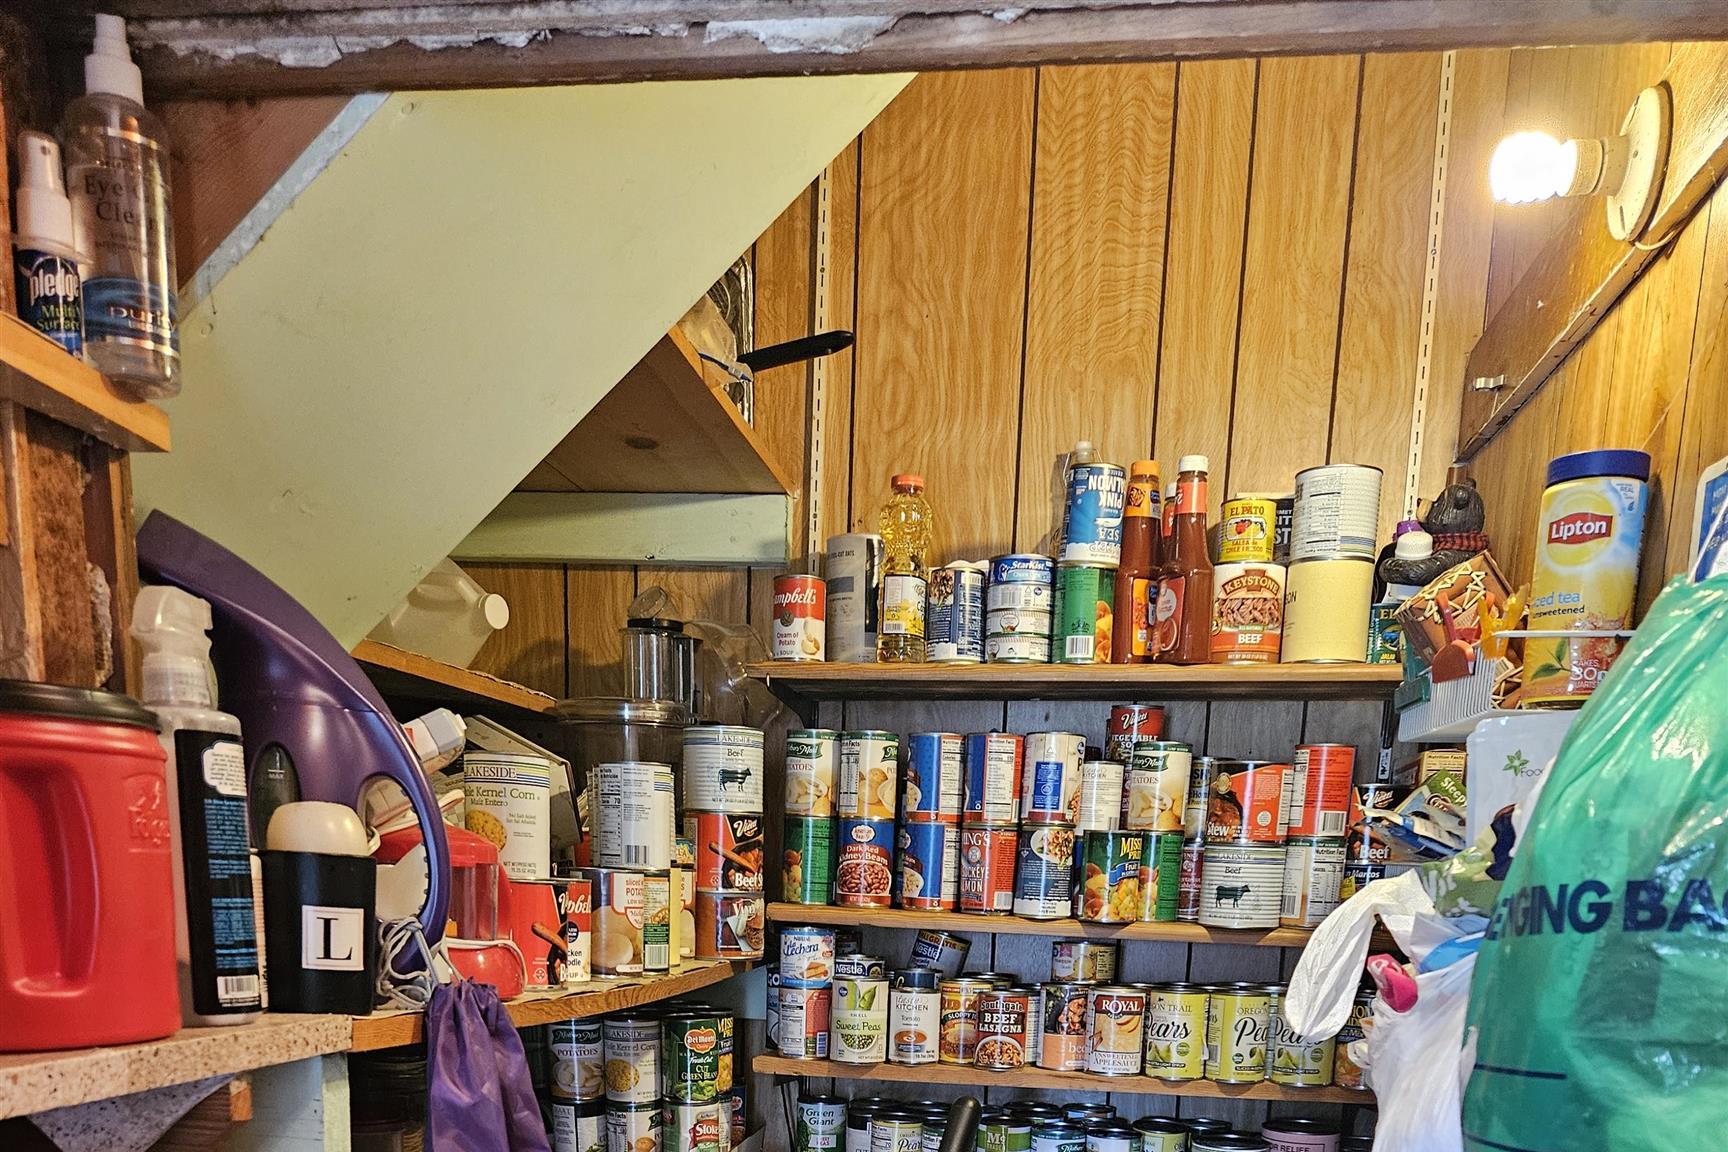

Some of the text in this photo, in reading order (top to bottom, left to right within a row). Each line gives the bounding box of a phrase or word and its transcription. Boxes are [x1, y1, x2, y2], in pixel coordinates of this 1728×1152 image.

[30, 267, 80, 306] pledge
[1099, 491, 1123, 509] PINK
[1230, 506, 1265, 516] EL PATO
[1099, 527, 1120, 541] SEA
[1551, 519, 1607, 540] Lipton
[1012, 560, 1045, 570] StarKist
[1224, 575, 1280, 595] KEYSTONE
[1558, 592, 1581, 604] tea
[778, 639, 796, 647] Potato
[1238, 633, 1263, 644] BEEF
[727, 749, 744, 757] Beef
[465, 767, 516, 778] LAKESIDE
[476, 787, 536, 800] Kernel Corn
[1207, 822, 1229, 837] Stew
[847, 845, 879, 854] Dark Red
[1360, 845, 1390, 860] Beef
[1224, 866, 1242, 875] Beef
[1352, 869, 1381, 879] Marcos
[735, 872, 757, 888] Beef
[1623, 879, 1728, 933] BA
[316, 917, 353, 960] L
[895, 1003, 929, 1012] KITCHEN
[981, 1000, 1024, 1013] Southgate
[1102, 999, 1140, 1015] ROYAL
[1168, 1004, 1192, 1012] TRAIL
[983, 1013, 1018, 1025] BEEF
[836, 1019, 881, 1032] Sweet Peas
[979, 1023, 1023, 1034] LASAGNA
[557, 1048, 598, 1056] POTATOES
[1094, 1057, 1139, 1067] APPLESAUCE
[695, 1065, 710, 1073] CUT
[681, 1072, 702, 1080] GREEN
[805, 1108, 835, 1117] Green
[808, 1117, 835, 1126] Giant
[897, 1138, 922, 1151] Pear
